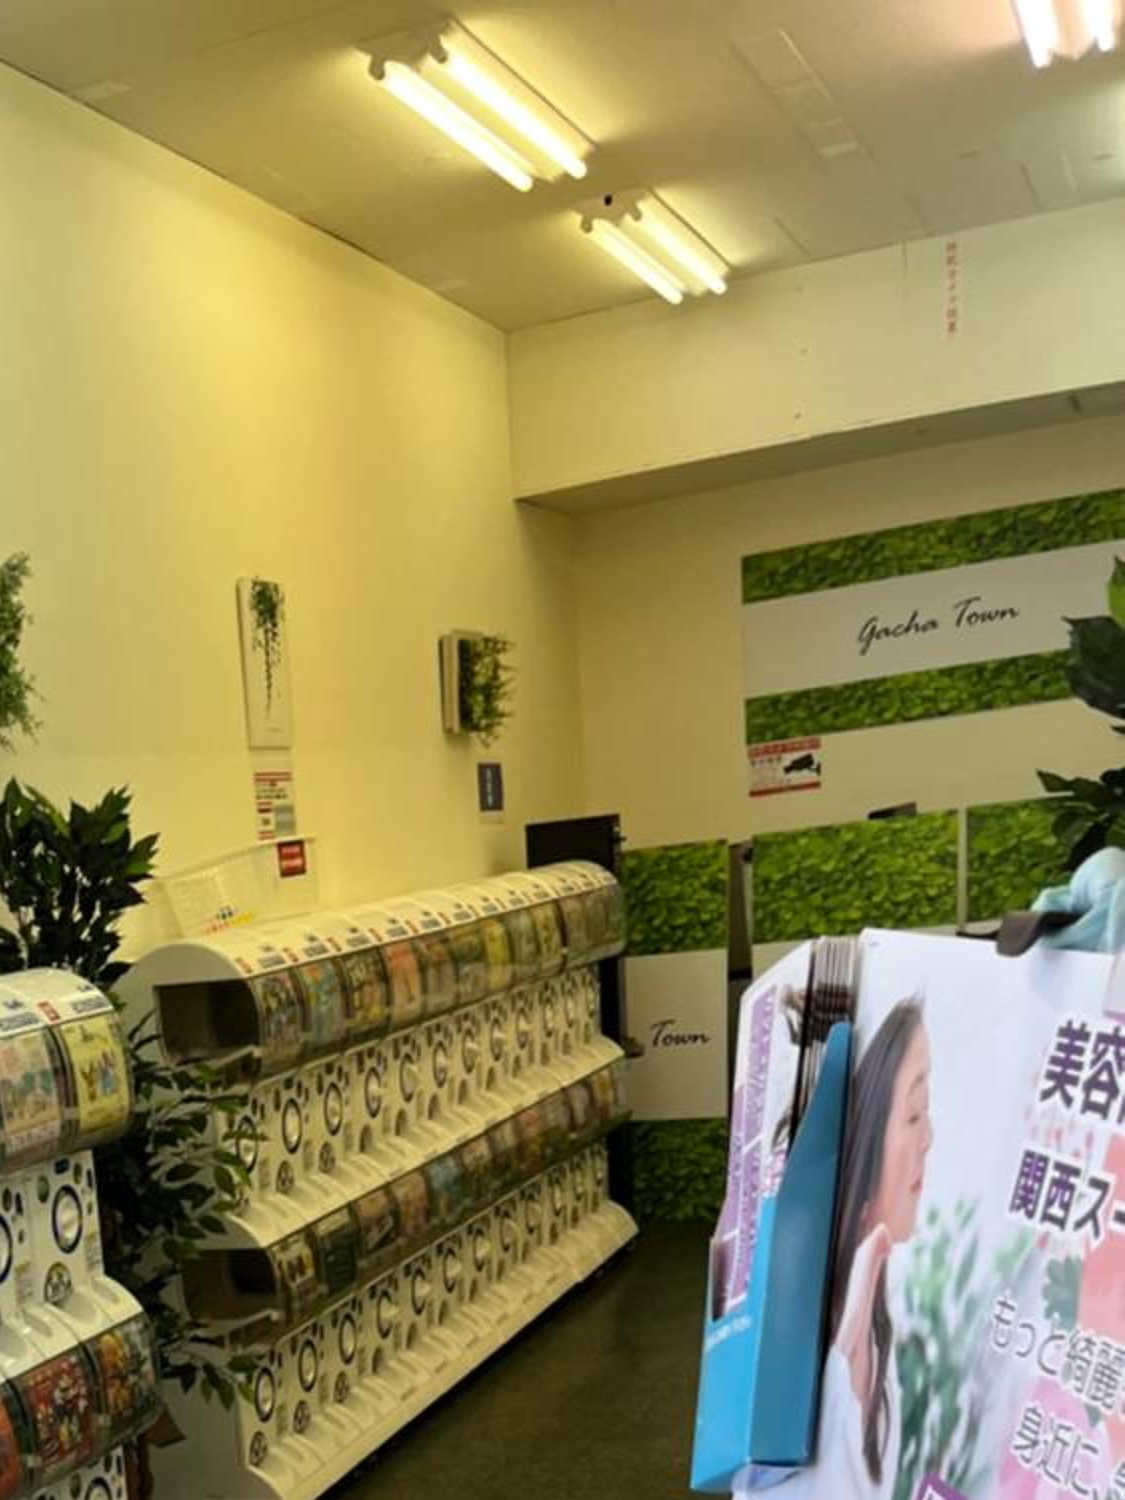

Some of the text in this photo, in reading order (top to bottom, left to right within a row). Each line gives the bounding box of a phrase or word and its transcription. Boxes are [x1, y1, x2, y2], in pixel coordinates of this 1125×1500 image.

[859, 597, 1020, 656] Gacha Town
[650, 1019, 711, 1048] Town
[1039, 1019, 1125, 1126] 美容
[1009, 1149, 1125, 1241] 関西ス
[994, 1297, 1125, 1412] もっと綺麗
